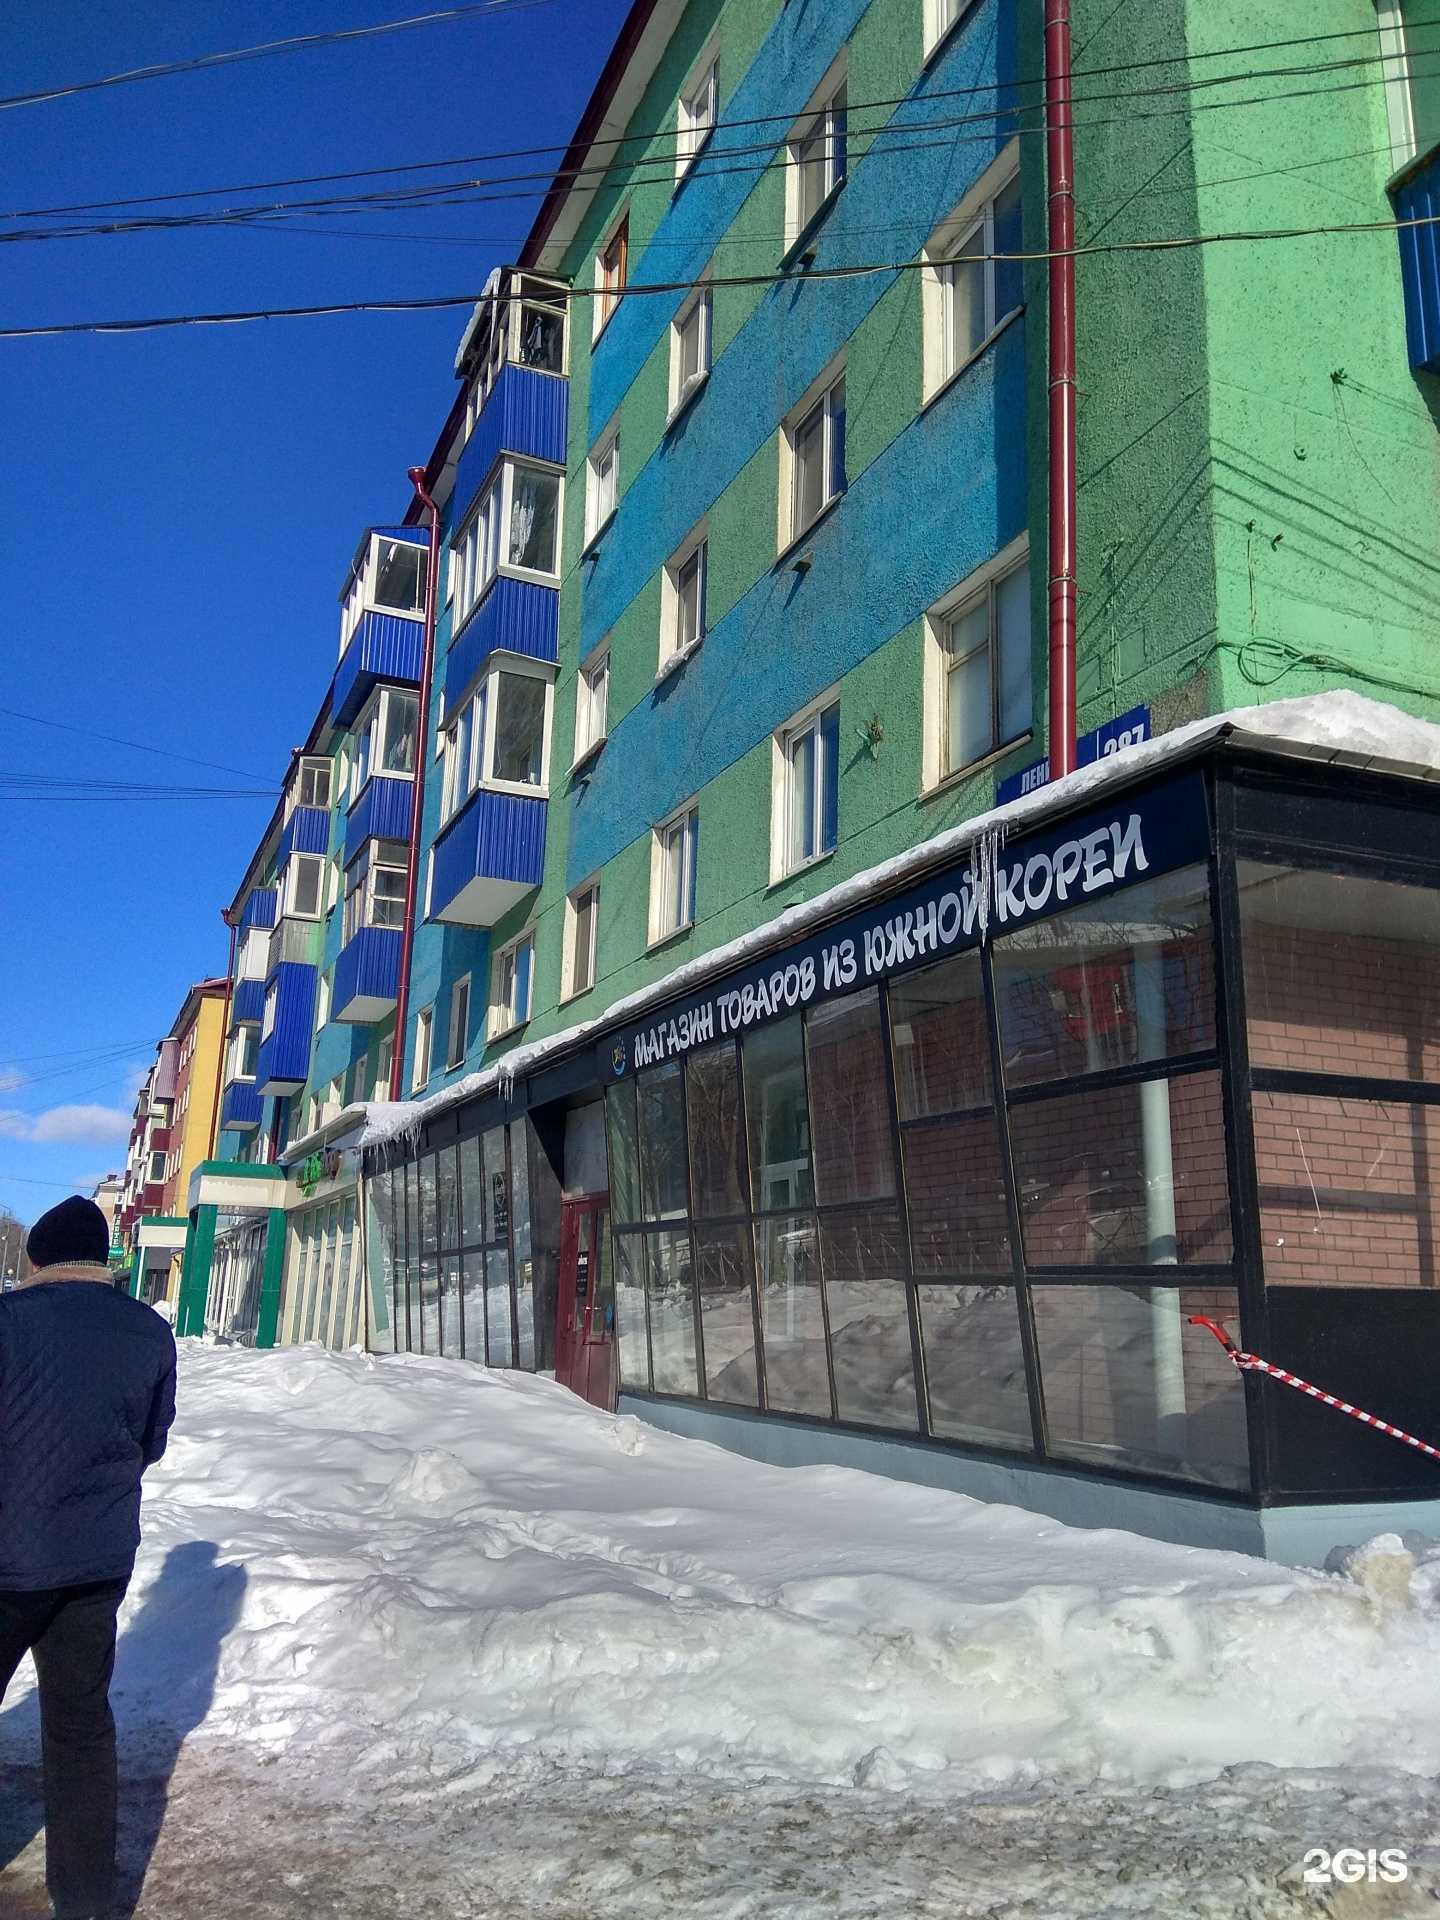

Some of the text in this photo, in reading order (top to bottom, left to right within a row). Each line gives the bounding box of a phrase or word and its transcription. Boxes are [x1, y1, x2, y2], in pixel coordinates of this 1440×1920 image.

[1103, 723, 1145, 757] 287
[634, 814, 1149, 1068] МАГАЗИН ТОВАРОВ ИЗ ЮЖНОЙ КОРЕИ
